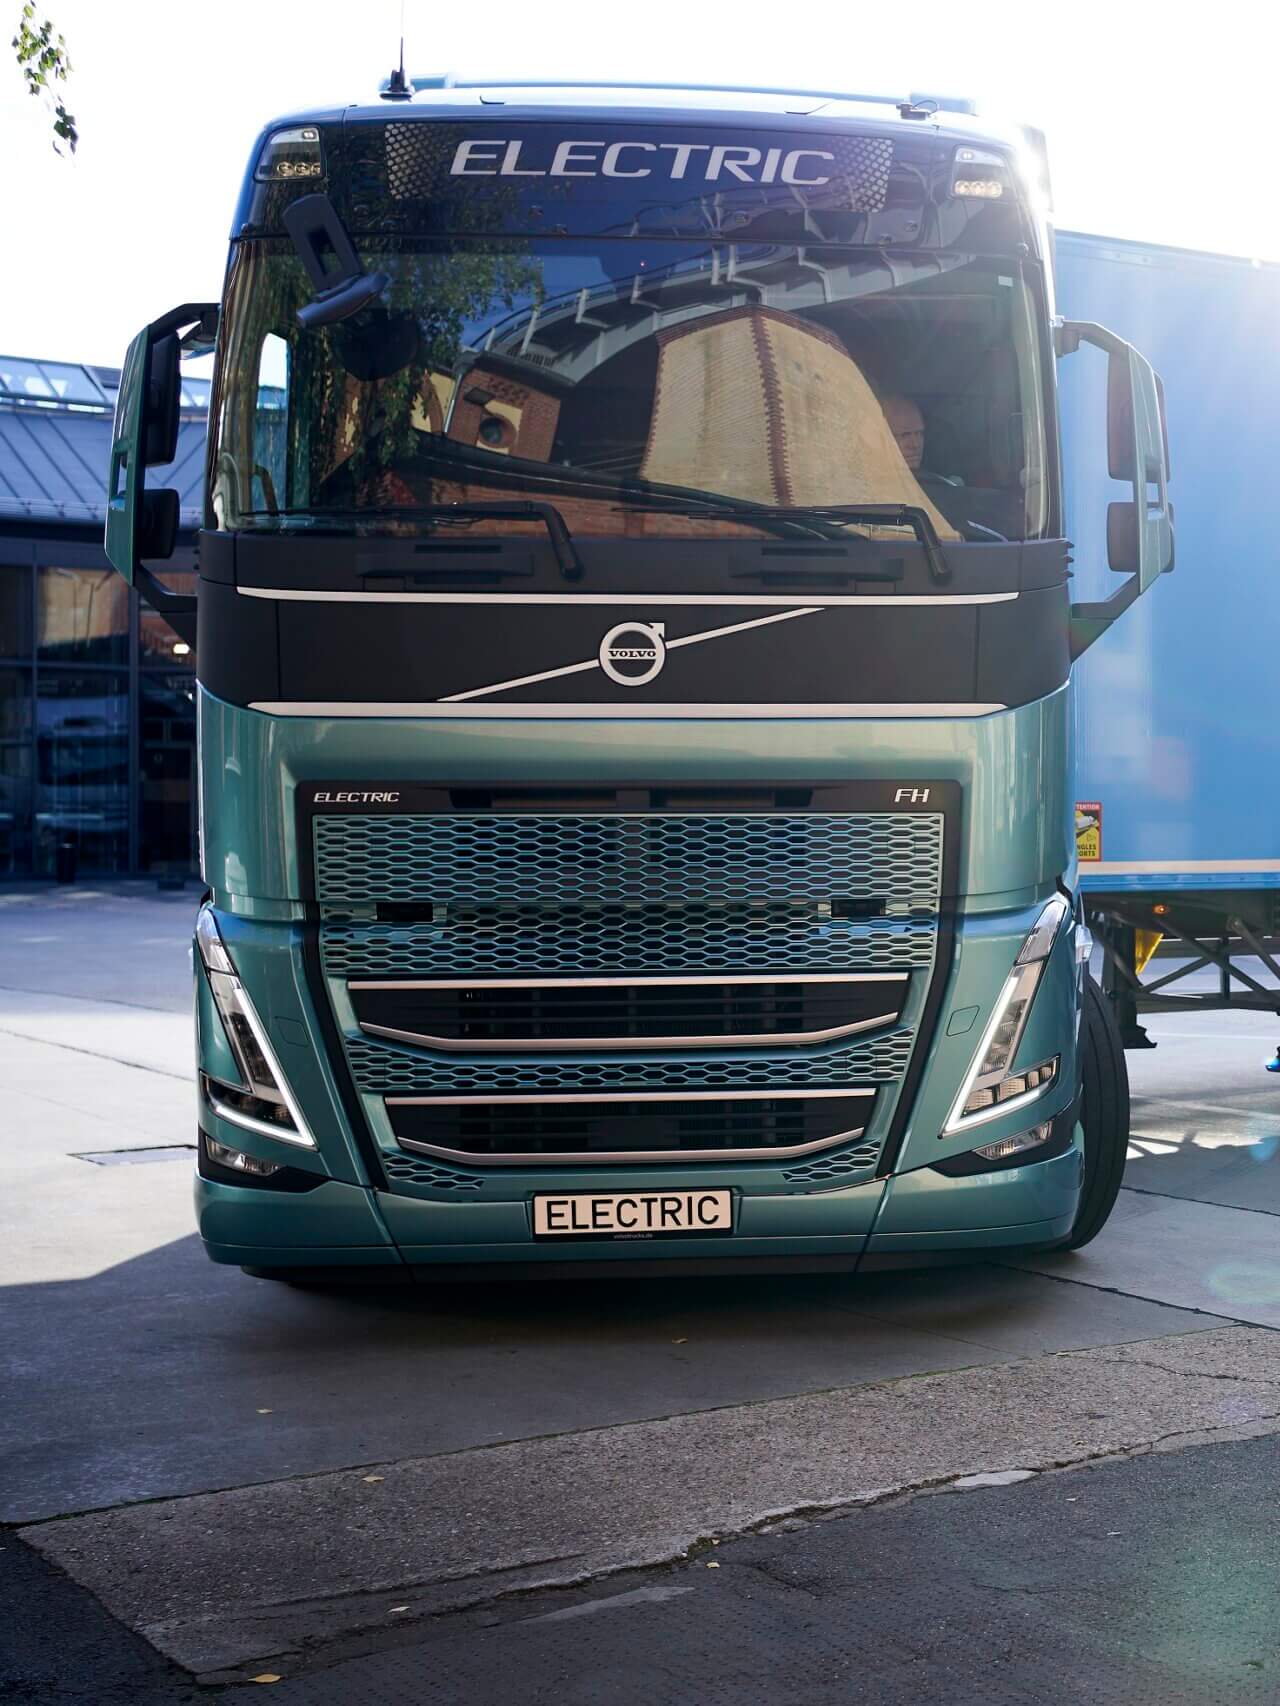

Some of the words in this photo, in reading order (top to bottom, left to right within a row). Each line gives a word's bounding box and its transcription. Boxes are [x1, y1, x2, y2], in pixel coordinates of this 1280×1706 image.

[450, 140, 835, 185] ELECTRIC
[608, 650, 656, 658] VOLVO
[313, 792, 400, 803] ELECTRIC
[894, 788, 930, 802] FH
[546, 1195, 719, 1230] ELECTRIC
